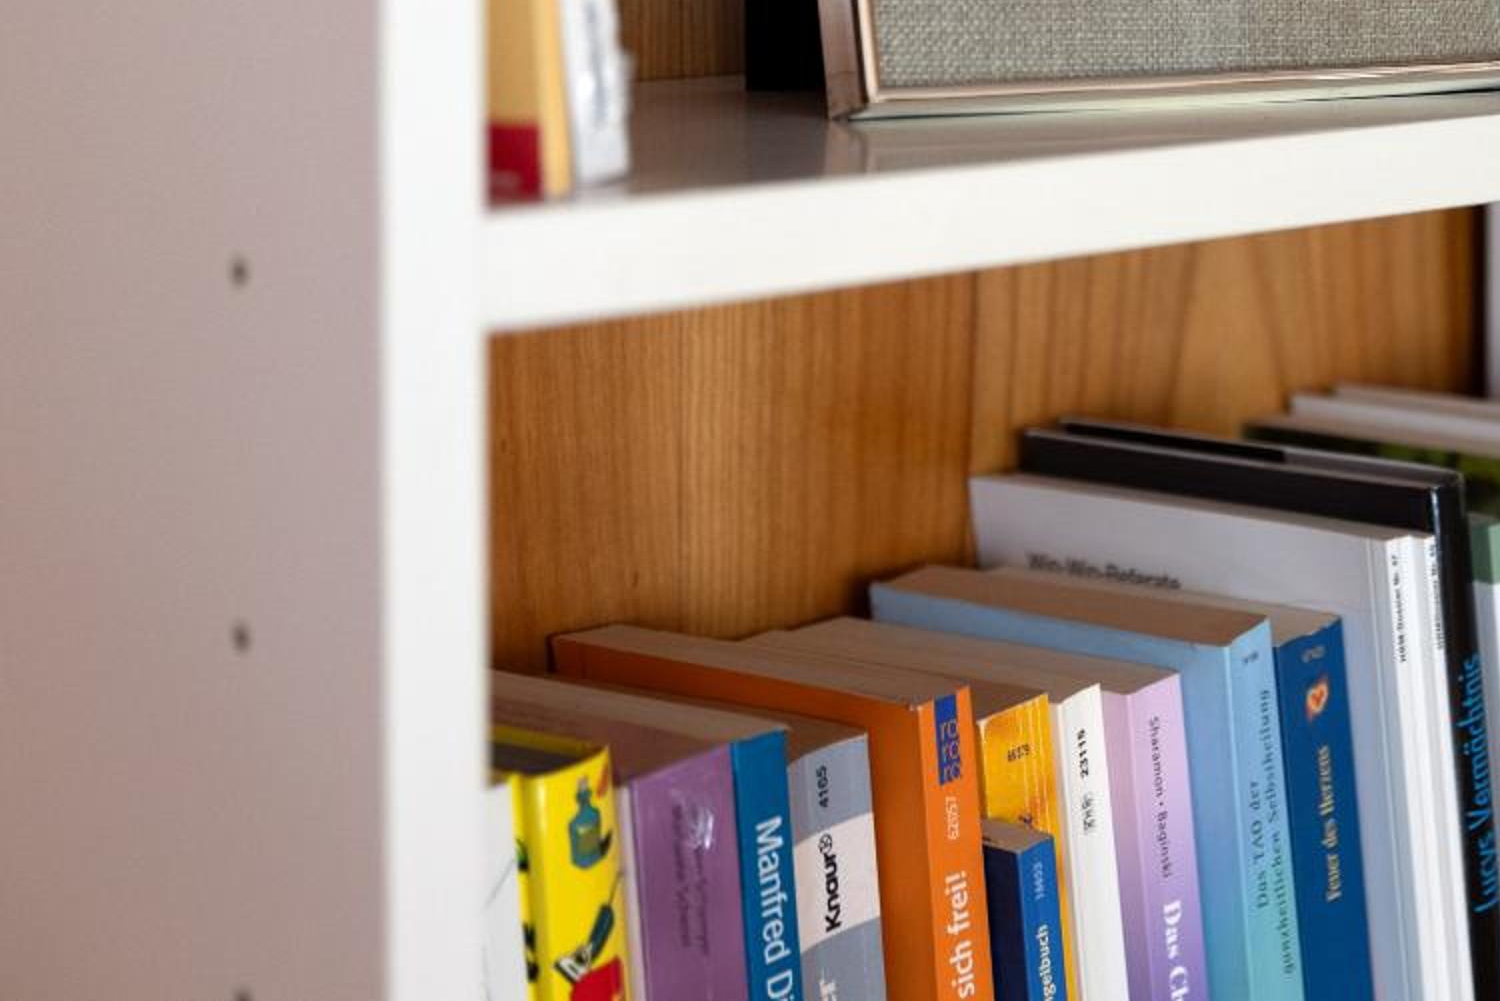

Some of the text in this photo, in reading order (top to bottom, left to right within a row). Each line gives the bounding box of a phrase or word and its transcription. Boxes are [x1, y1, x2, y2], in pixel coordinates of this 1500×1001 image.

[1146, 715, 1172, 879] Sharamon Baginski
[1247, 780, 1270, 910] Das TAO der
[1315, 744, 1343, 903] Feuer des Herzens
[1456, 653, 1499, 914] Lucys Vermächtnis
[754, 815, 791, 965] Manfred
[824, 854, 842, 932] Knaur
[1161, 899, 1180, 960] Das
[949, 940, 975, 999] sich
